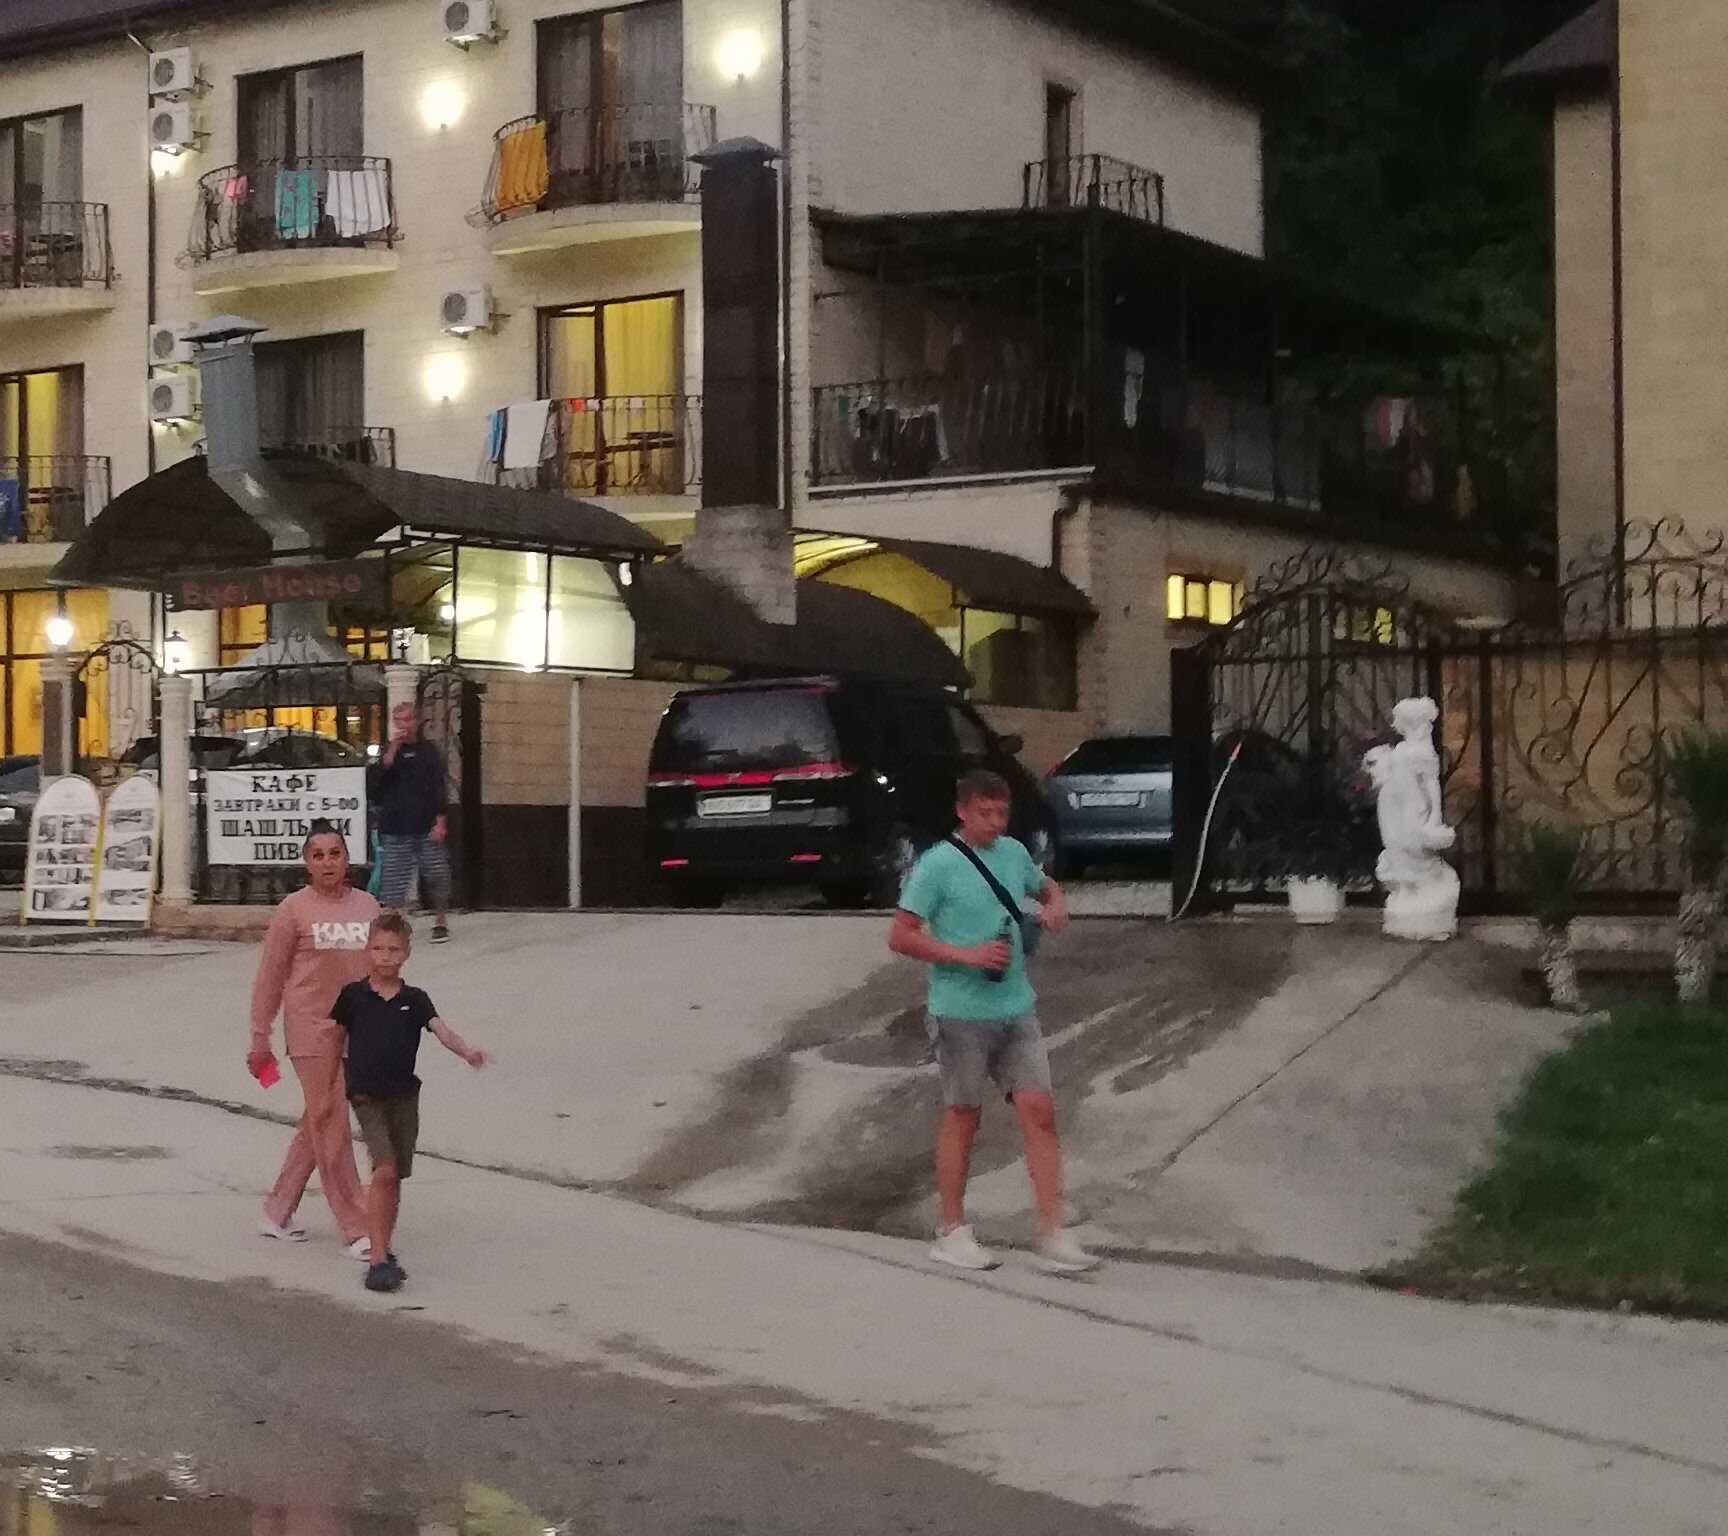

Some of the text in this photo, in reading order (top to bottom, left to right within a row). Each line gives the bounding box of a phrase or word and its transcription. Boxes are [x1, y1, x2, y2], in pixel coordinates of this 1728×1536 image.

[252, 774, 318, 793] КАФЕ
[213, 798, 301, 812] ЗАВТРАКИ
[320, 797, 359, 811] 5-00
[220, 817, 352, 837] ШАШЛЫИ
[253, 841, 303, 861] ПИВ
